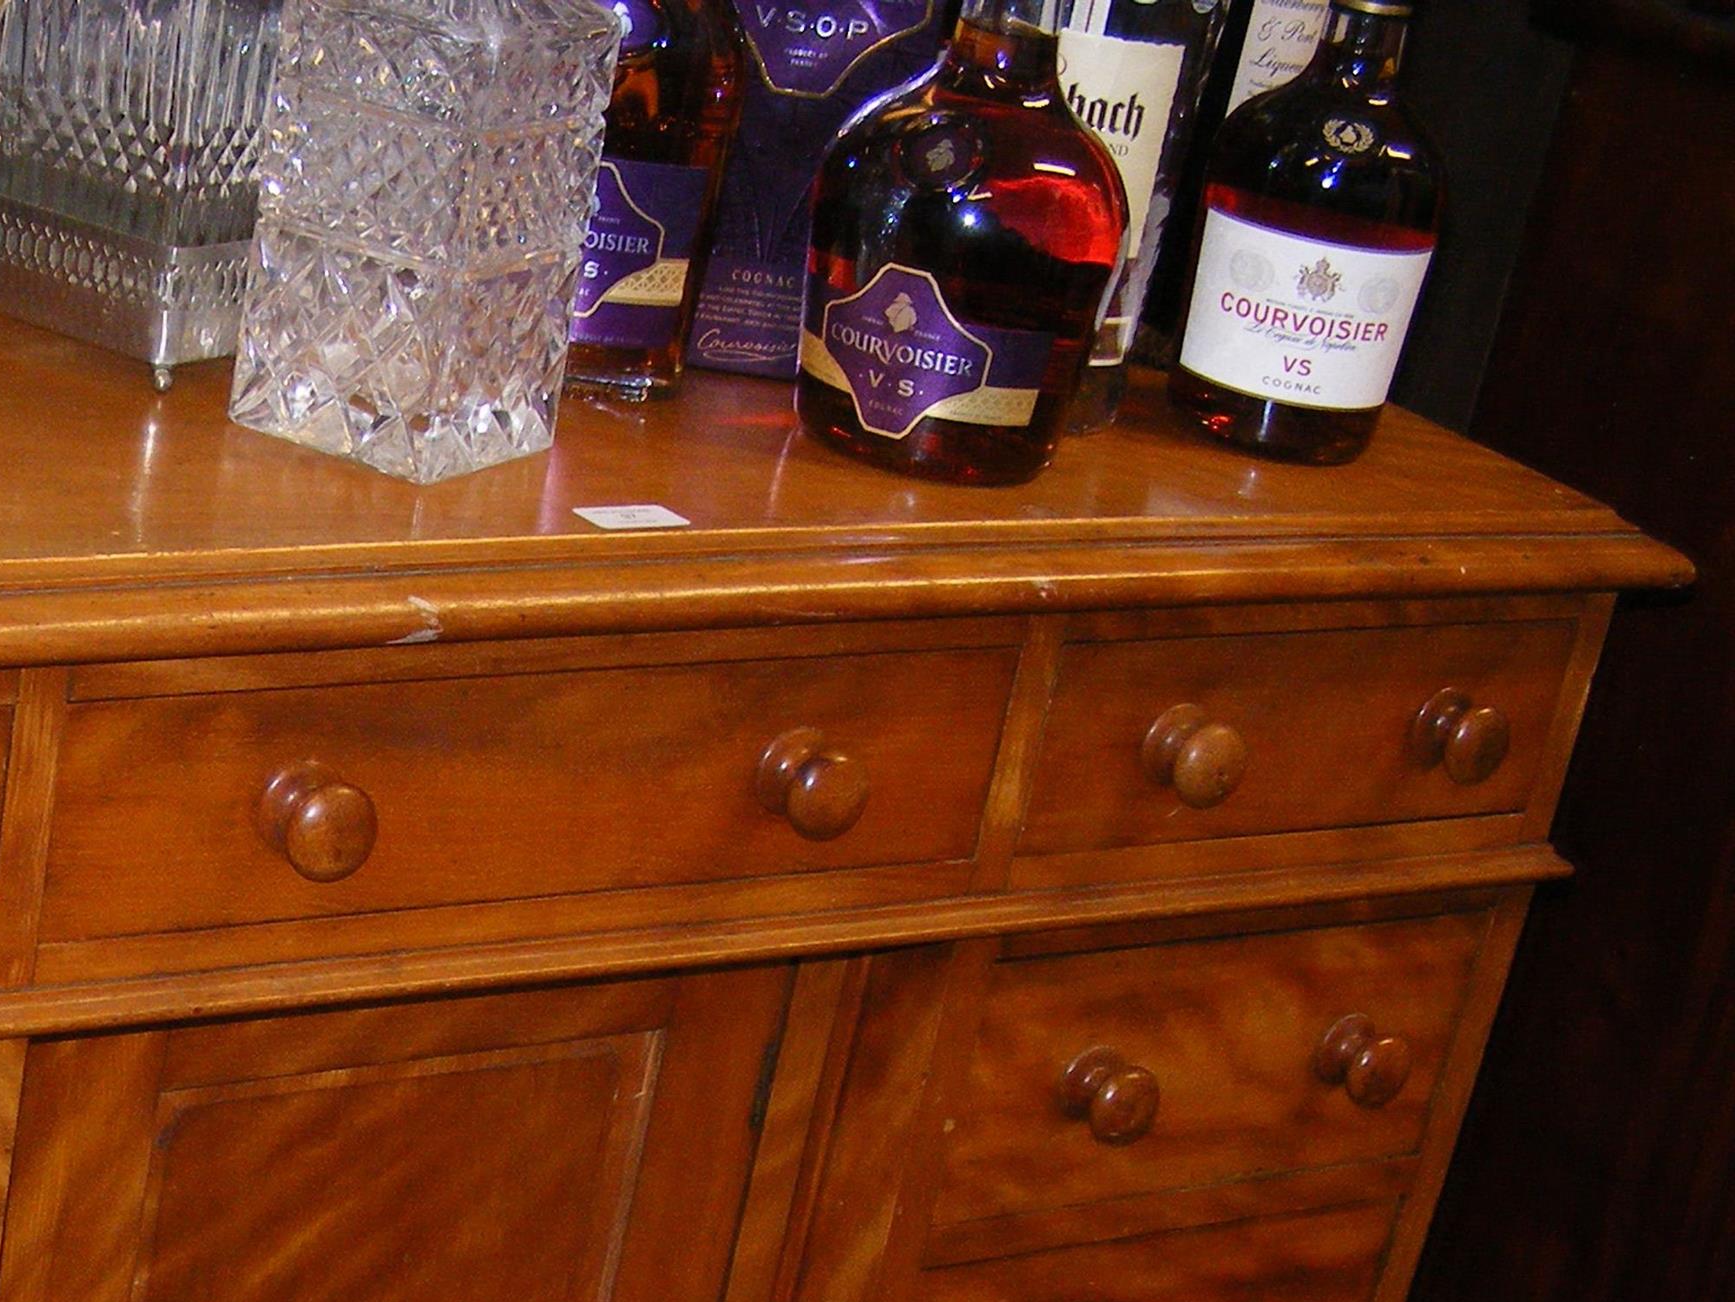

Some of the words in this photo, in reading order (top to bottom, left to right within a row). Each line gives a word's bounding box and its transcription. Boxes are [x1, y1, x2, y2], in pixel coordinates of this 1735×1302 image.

[1257, 16, 1281, 42] &
[1249, 46, 1304, 77] Liqueu
[1067, 82, 1145, 142] bach
[731, 269, 796, 288] COGNAC
[1220, 291, 1389, 342] COURVOISIER
[831, 322, 974, 378] COURVOISIER
[1283, 356, 1313, 377] VS
[1262, 376, 1322, 396] COGNAC
